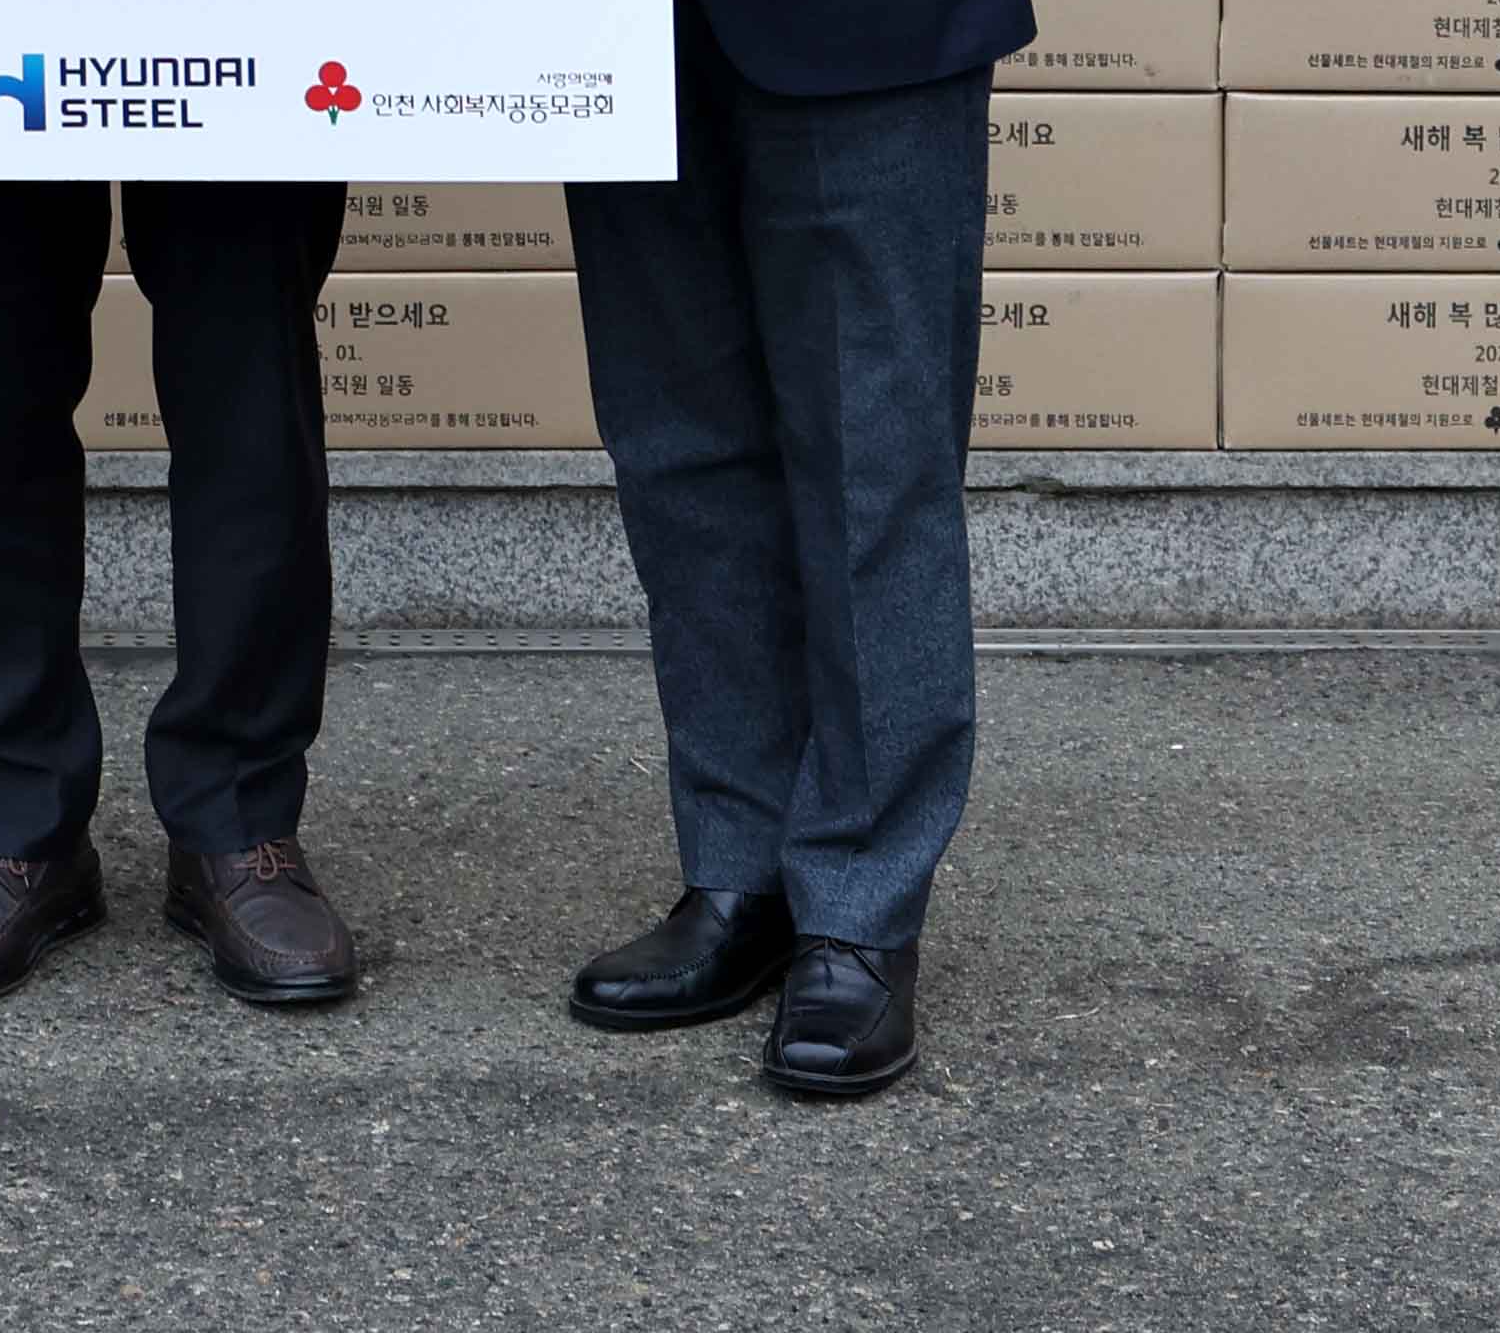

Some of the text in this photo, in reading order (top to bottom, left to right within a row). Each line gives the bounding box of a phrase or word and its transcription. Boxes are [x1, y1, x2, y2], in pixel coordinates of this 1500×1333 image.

[60, 57, 255, 87] HYUNDAI
[61, 99, 203, 128] STEEL
[373, 94, 613, 123] 인천 사회복지공동모금회
